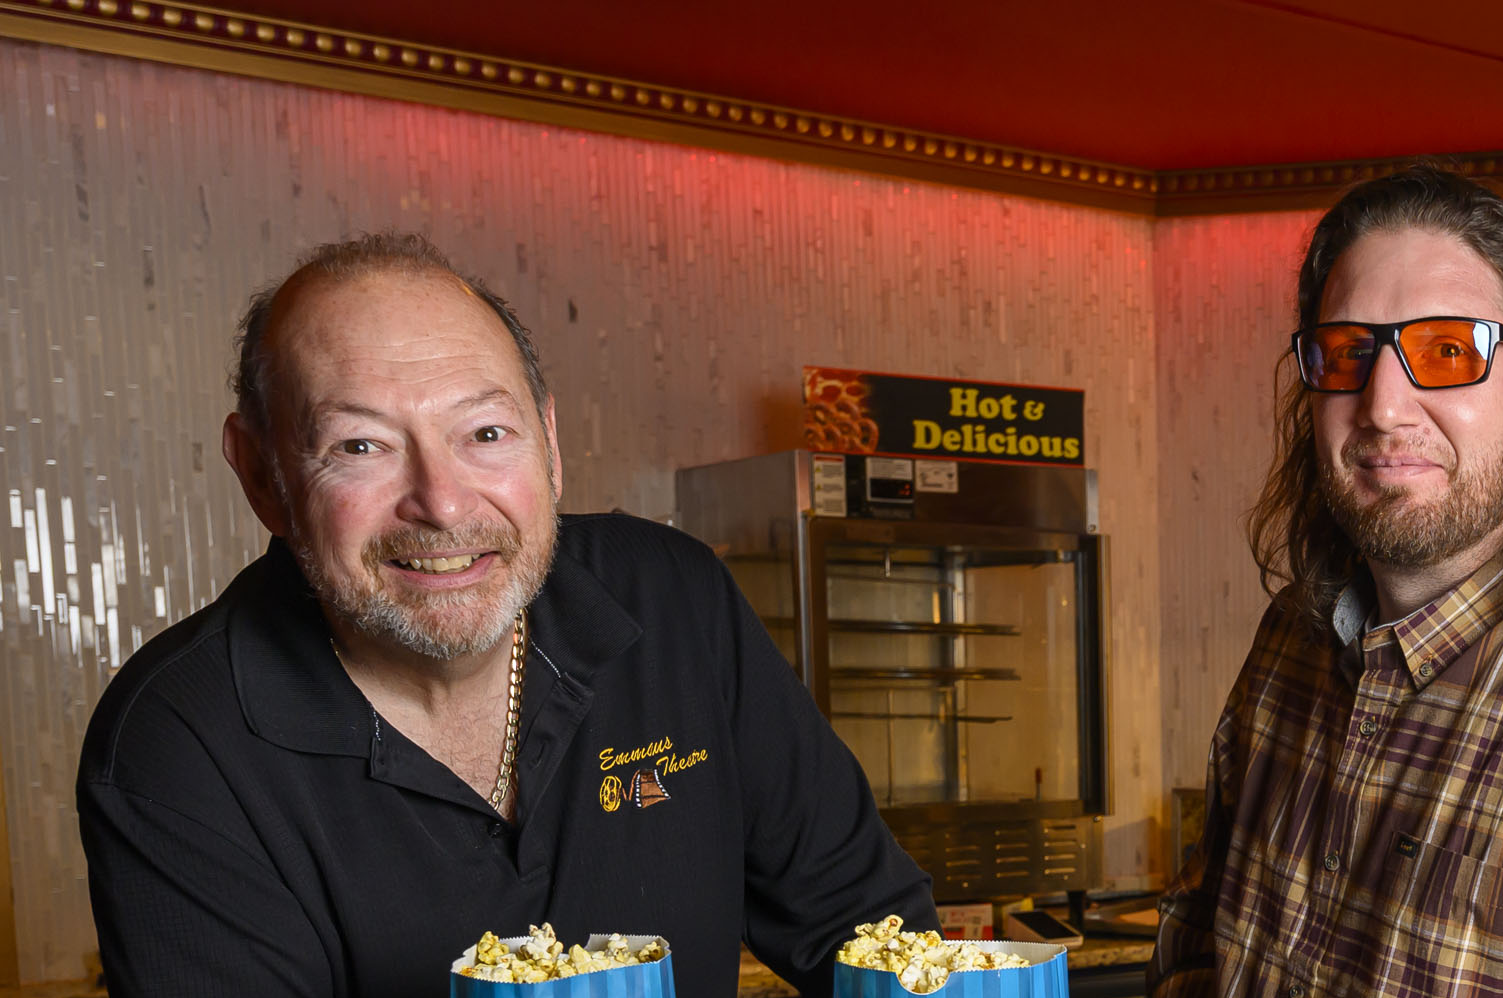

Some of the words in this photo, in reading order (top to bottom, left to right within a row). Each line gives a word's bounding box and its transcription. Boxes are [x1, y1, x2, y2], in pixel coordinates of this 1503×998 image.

[949, 387, 1017, 420] Hot
[1023, 401, 1045, 422] &
[913, 420, 1080, 459] Delicious
